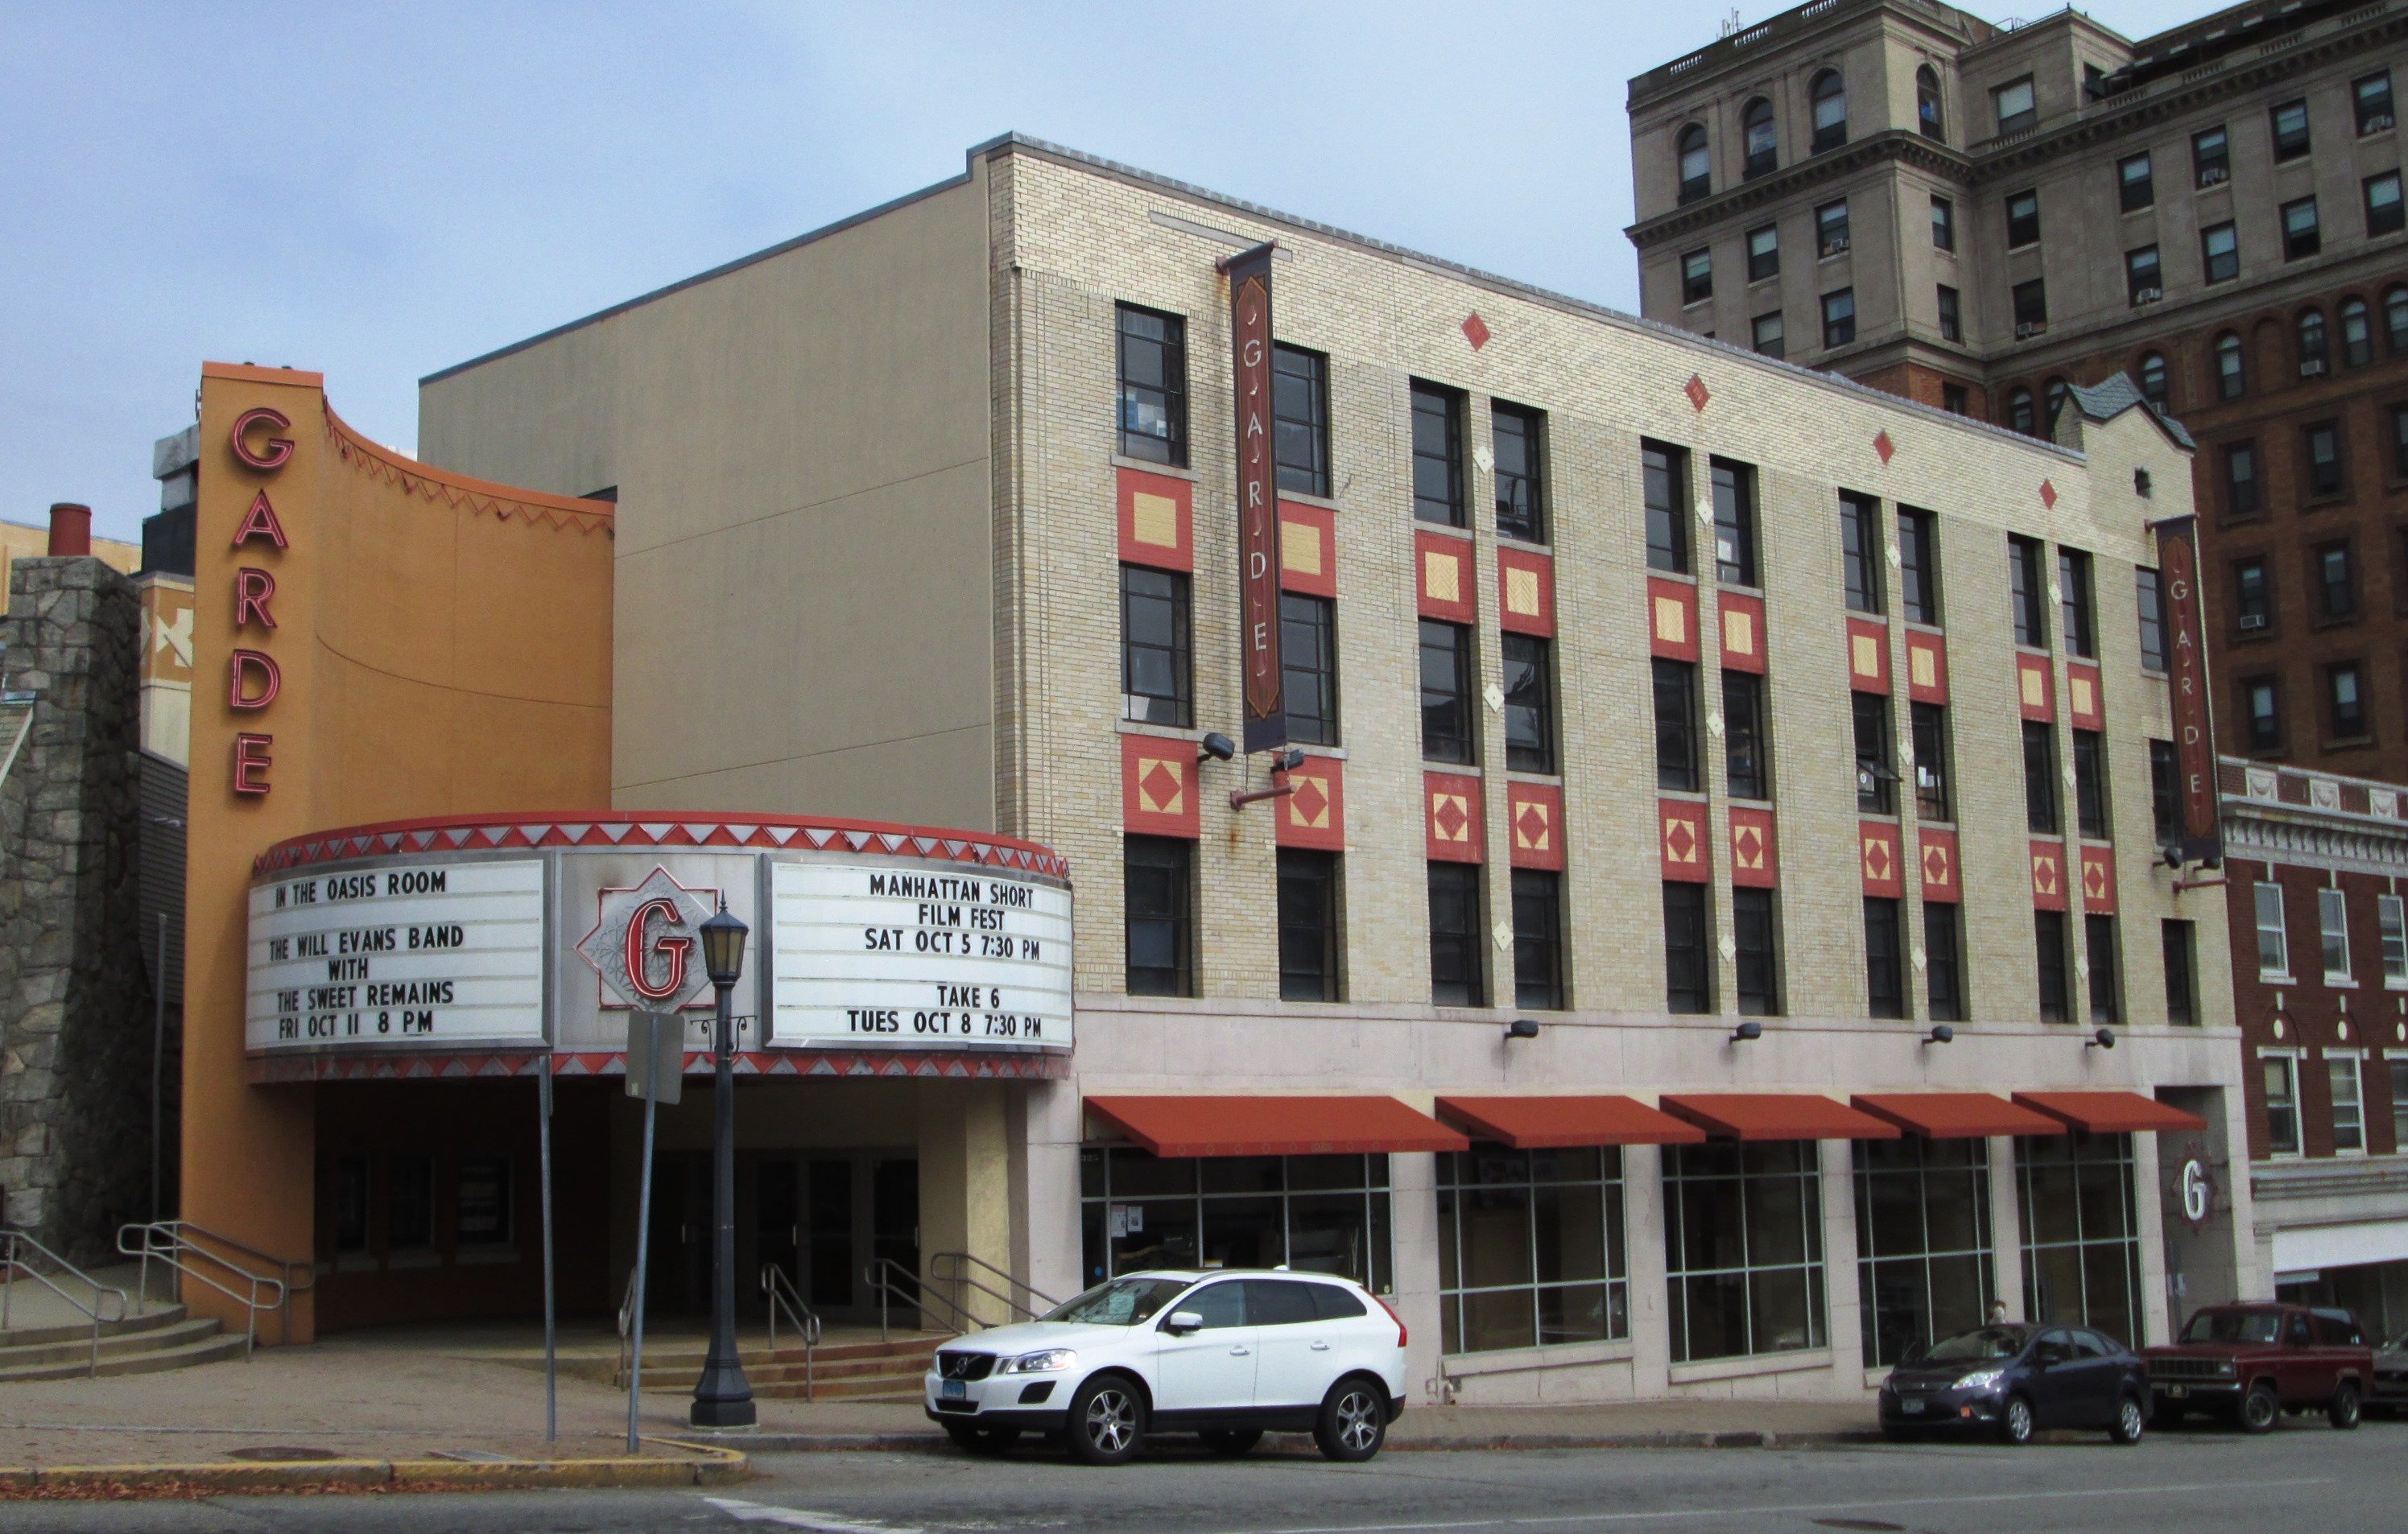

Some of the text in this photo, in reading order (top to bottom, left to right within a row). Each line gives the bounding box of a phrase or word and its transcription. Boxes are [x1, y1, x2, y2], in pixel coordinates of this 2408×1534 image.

[1243, 339, 1266, 650] GARDE
[230, 407, 295, 794] GARDE
[2171, 579, 2201, 794] GARDE
[275, 870, 446, 909] IN THE OASIS ROOM
[870, 874, 1033, 908] MANHATTAN SHORT
[919, 903, 1006, 931] FILM FEST
[270, 925, 464, 960] THE WILL EVANS BAND
[626, 897, 693, 999] G
[865, 928, 1040, 961] SAT OCT 5 7:30 PM
[328, 957, 369, 982] WITH
[277, 980, 454, 1012] THE SWEET REMAINS
[937, 985, 1001, 1009] TAKE 6
[279, 1009, 433, 1039] FRI OCT 11 8 PM
[847, 1009, 1042, 1038] TUES OCT 8 7:30 PM
[2183, 1160, 2207, 1221] G
